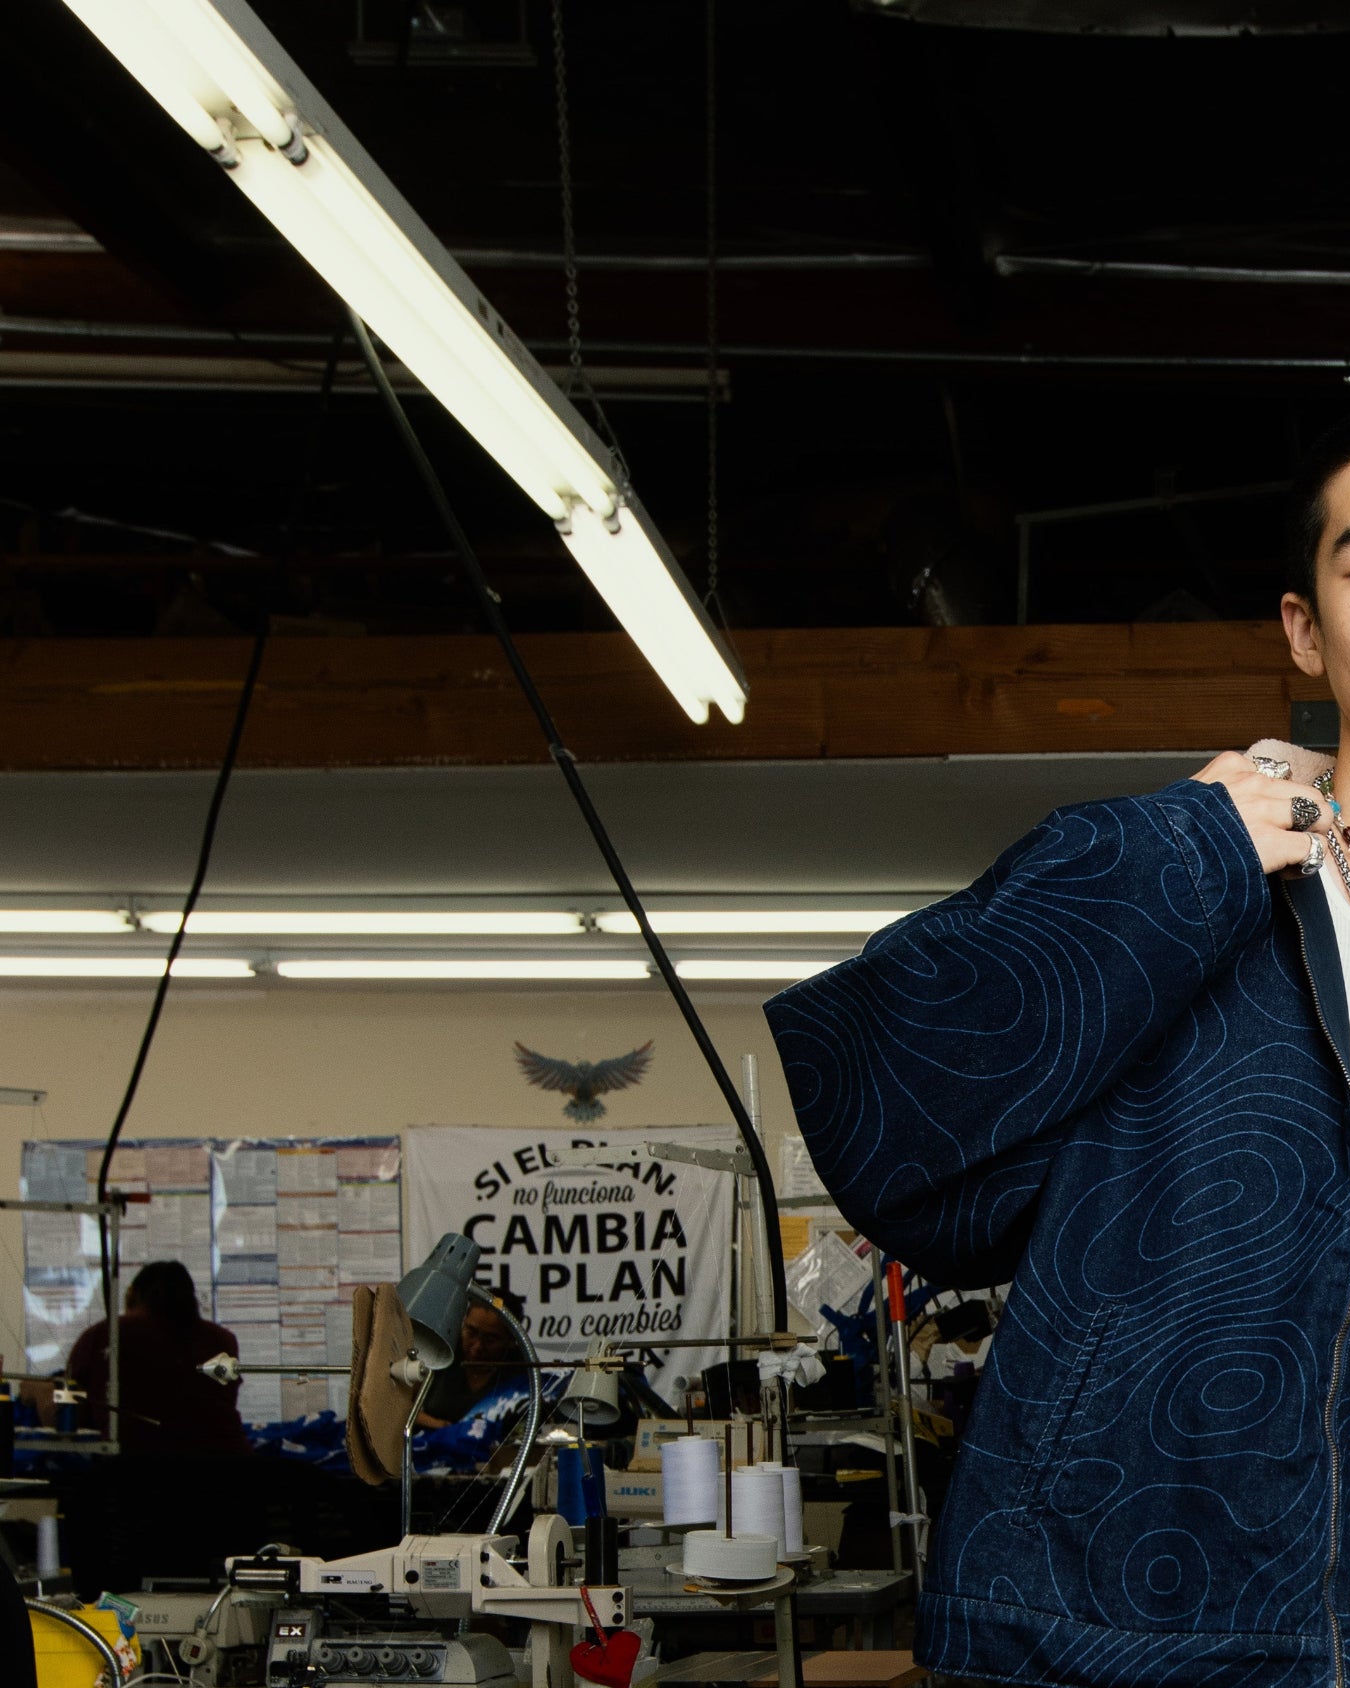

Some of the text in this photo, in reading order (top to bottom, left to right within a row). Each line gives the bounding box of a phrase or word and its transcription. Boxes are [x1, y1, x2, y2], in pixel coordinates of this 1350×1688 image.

[512, 1180, 636, 1213] no funciona
[463, 1208, 688, 1255] CAMBIA
[539, 1256, 687, 1304] PLAN
[539, 1314, 571, 1337] no
[580, 1302, 682, 1337] cambies
[613, 1486, 657, 1497] JUKI
[279, 1626, 303, 1636] EX
